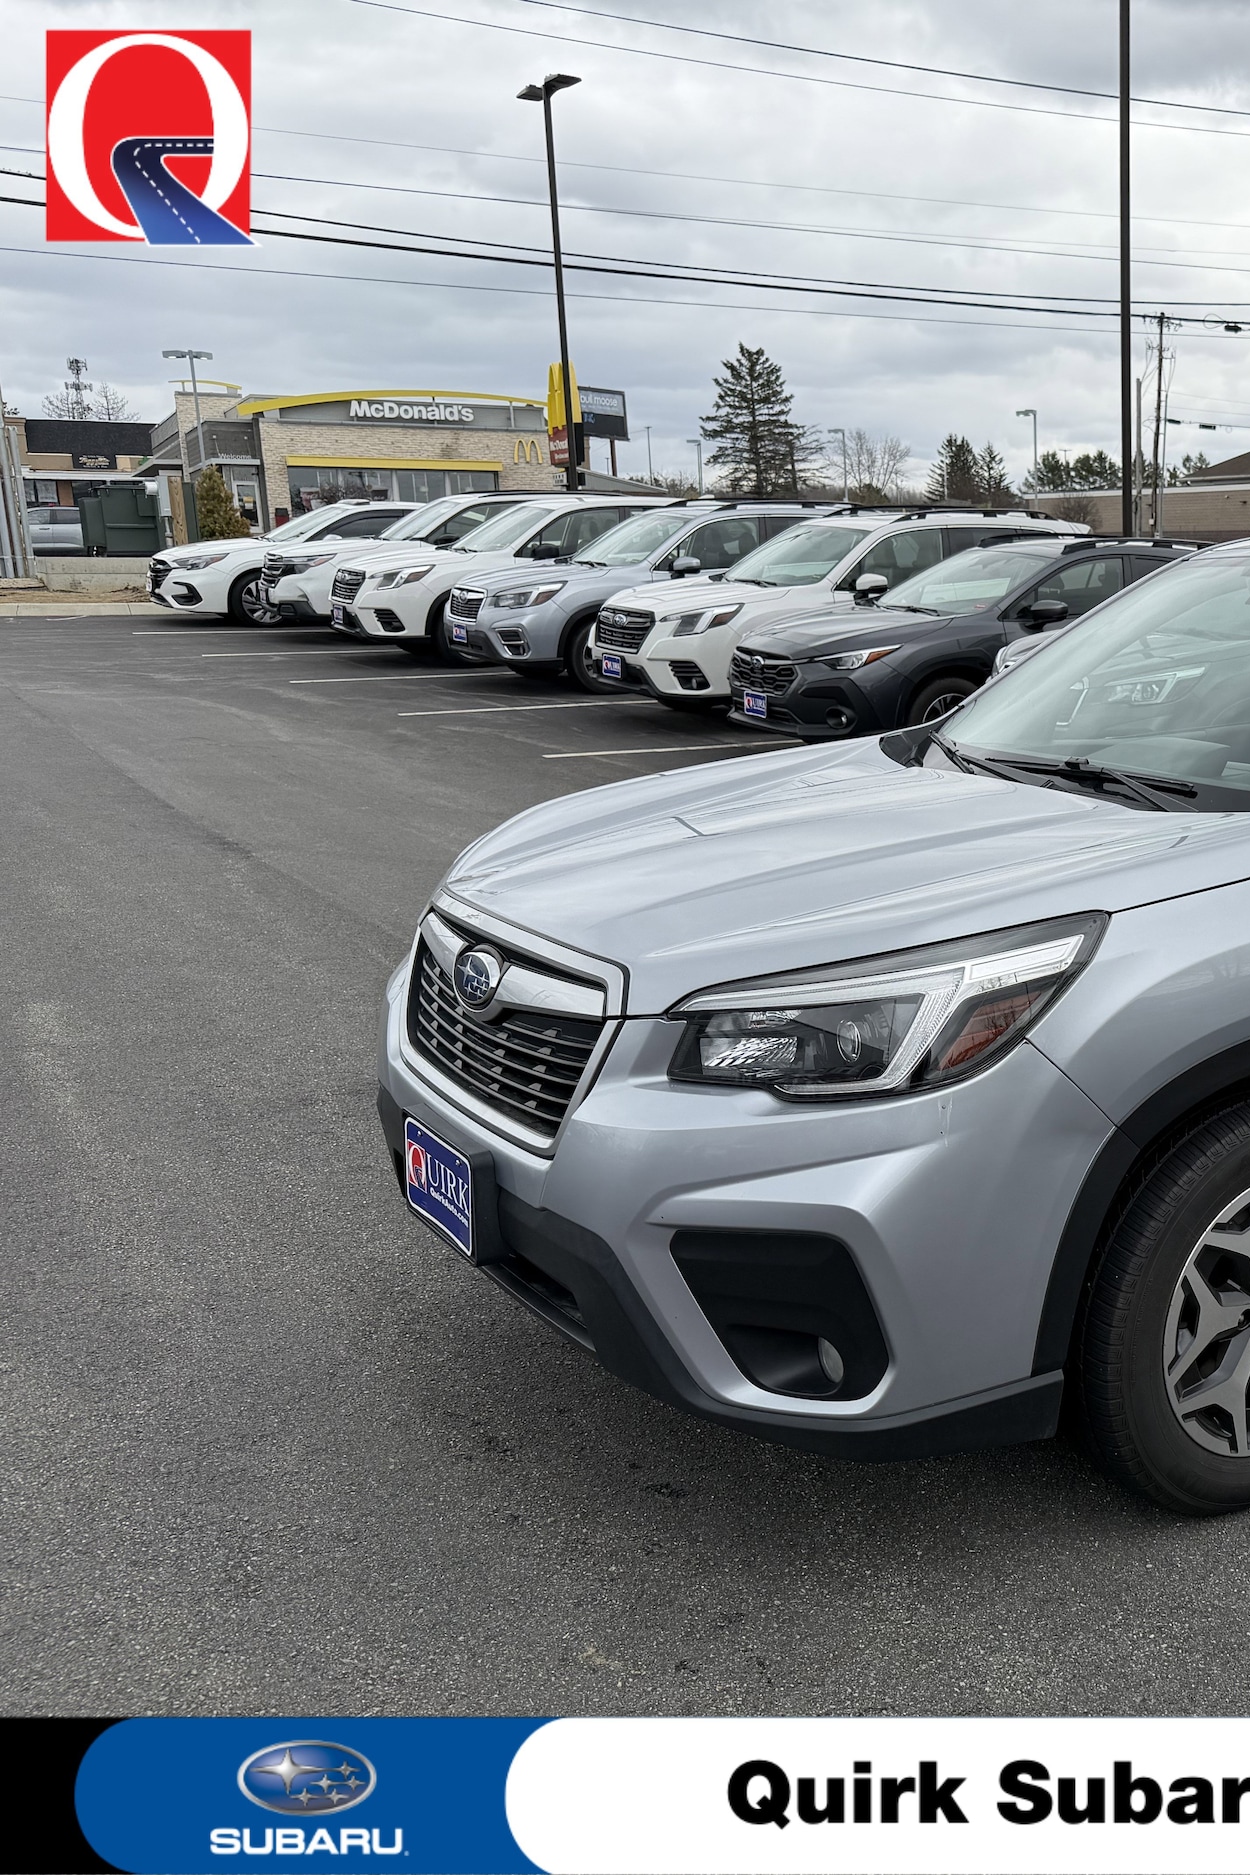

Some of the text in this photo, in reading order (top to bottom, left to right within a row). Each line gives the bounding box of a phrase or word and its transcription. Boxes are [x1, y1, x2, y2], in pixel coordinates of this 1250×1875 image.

[350, 400, 474, 421] McDonald's
[593, 396, 618, 407] moose
[408, 1143, 470, 1216] QUIRK
[430, 1187, 470, 1228] QuirkAuto.com
